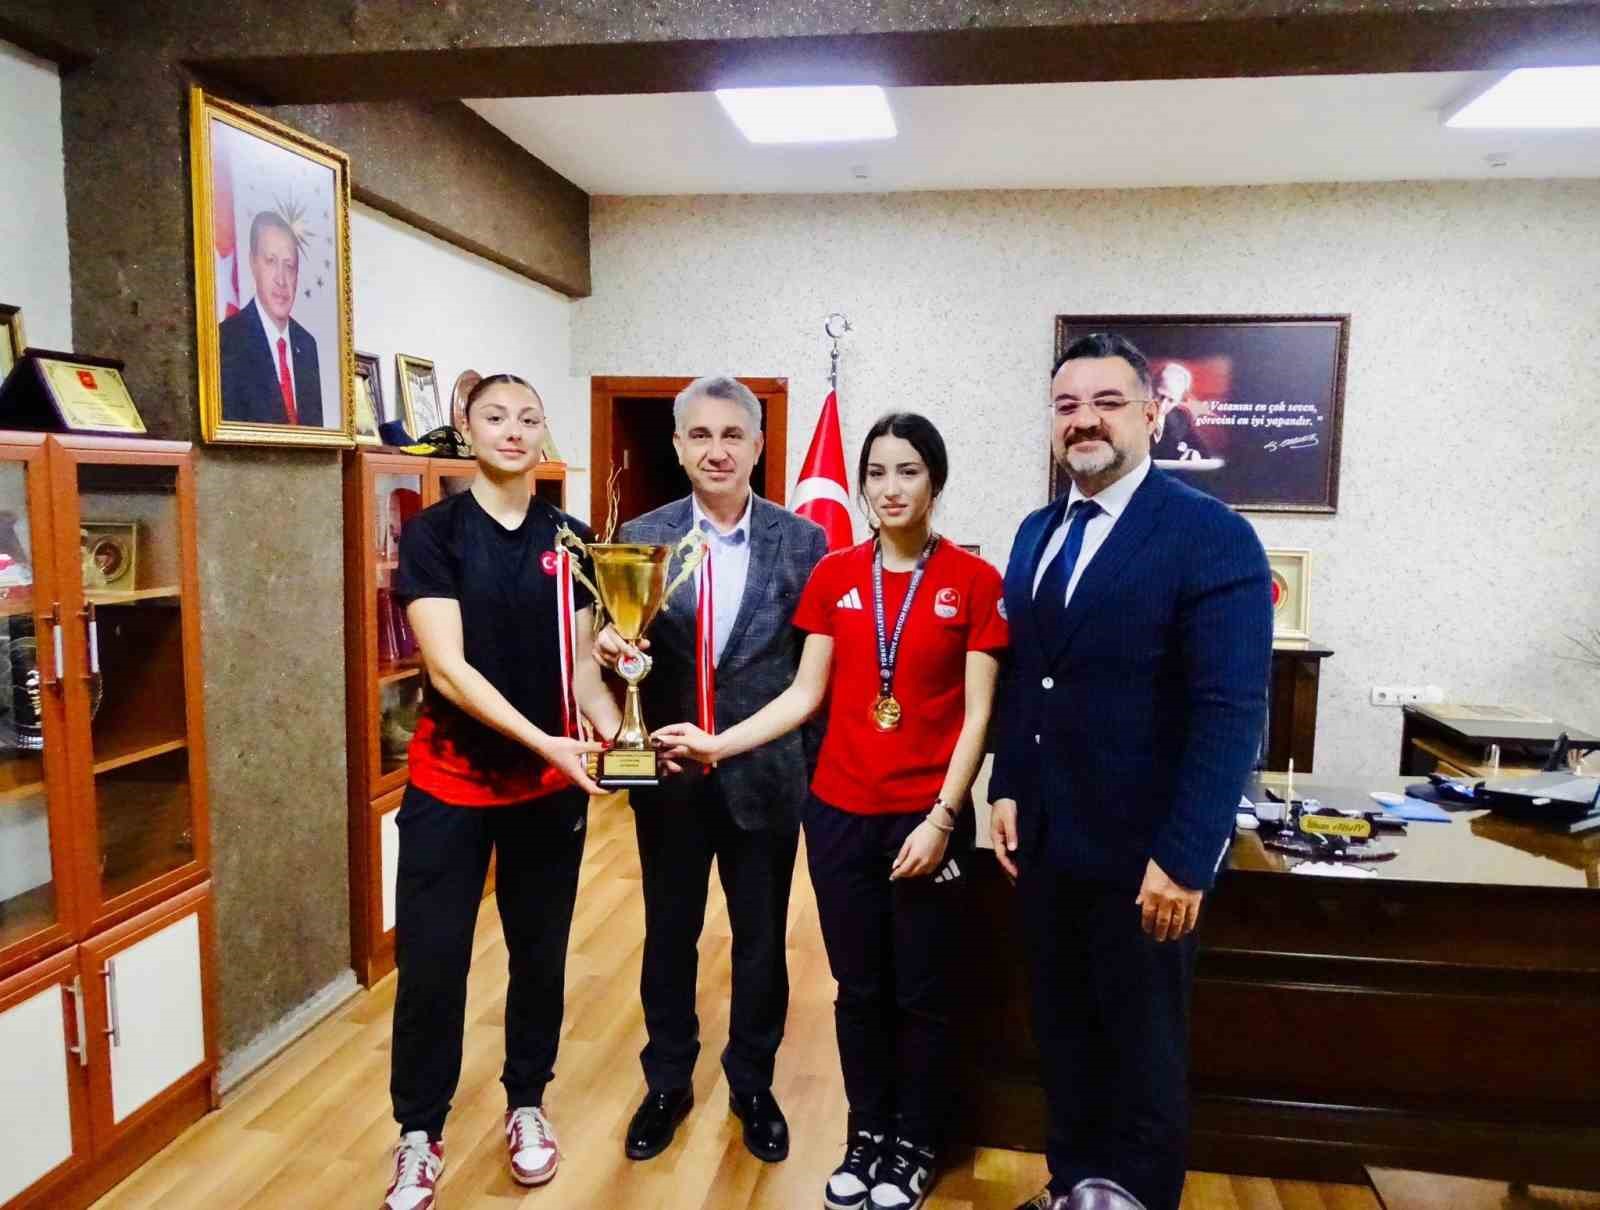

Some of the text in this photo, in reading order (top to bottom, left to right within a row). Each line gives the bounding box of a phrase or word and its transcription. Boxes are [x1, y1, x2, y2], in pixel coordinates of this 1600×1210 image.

[1254, 404, 1267, 412] en
[1268, 401, 1285, 414] çok
[1237, 416, 1250, 425] en
[1251, 414, 1265, 427] iyi
